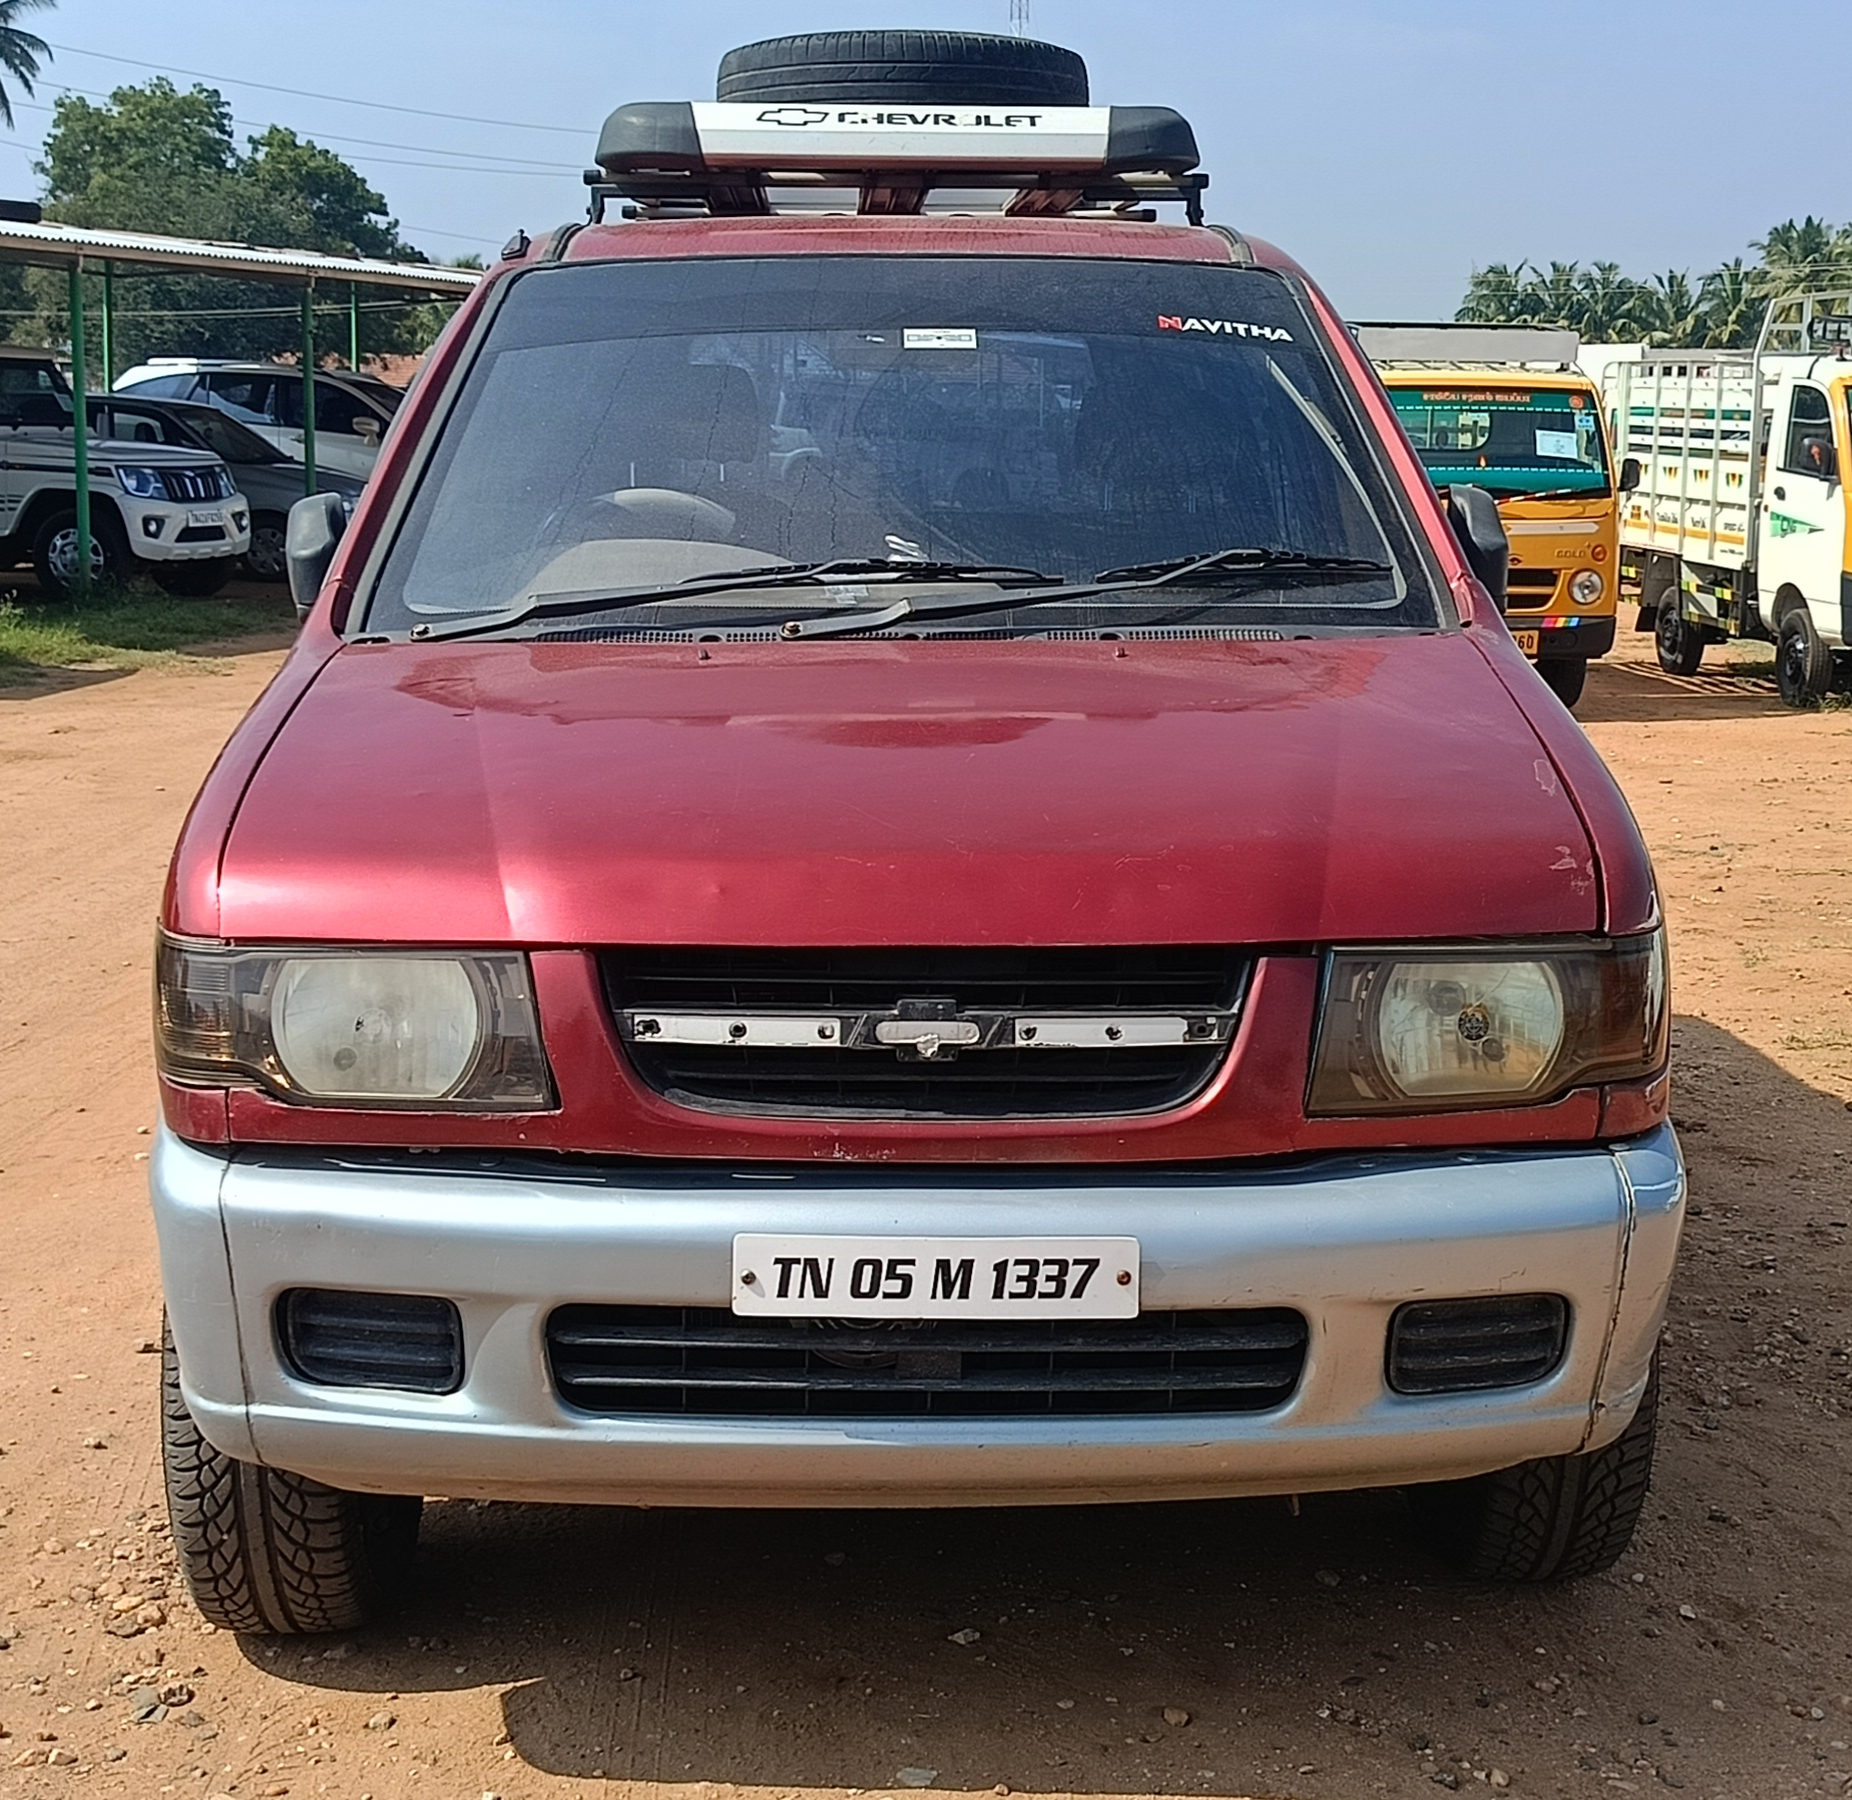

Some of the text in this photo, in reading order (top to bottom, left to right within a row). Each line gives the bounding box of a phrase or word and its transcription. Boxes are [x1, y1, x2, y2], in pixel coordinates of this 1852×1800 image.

[1157, 315, 1294, 342] NAVITHA
[773, 1257, 1102, 1300] TN 05 M 1337
